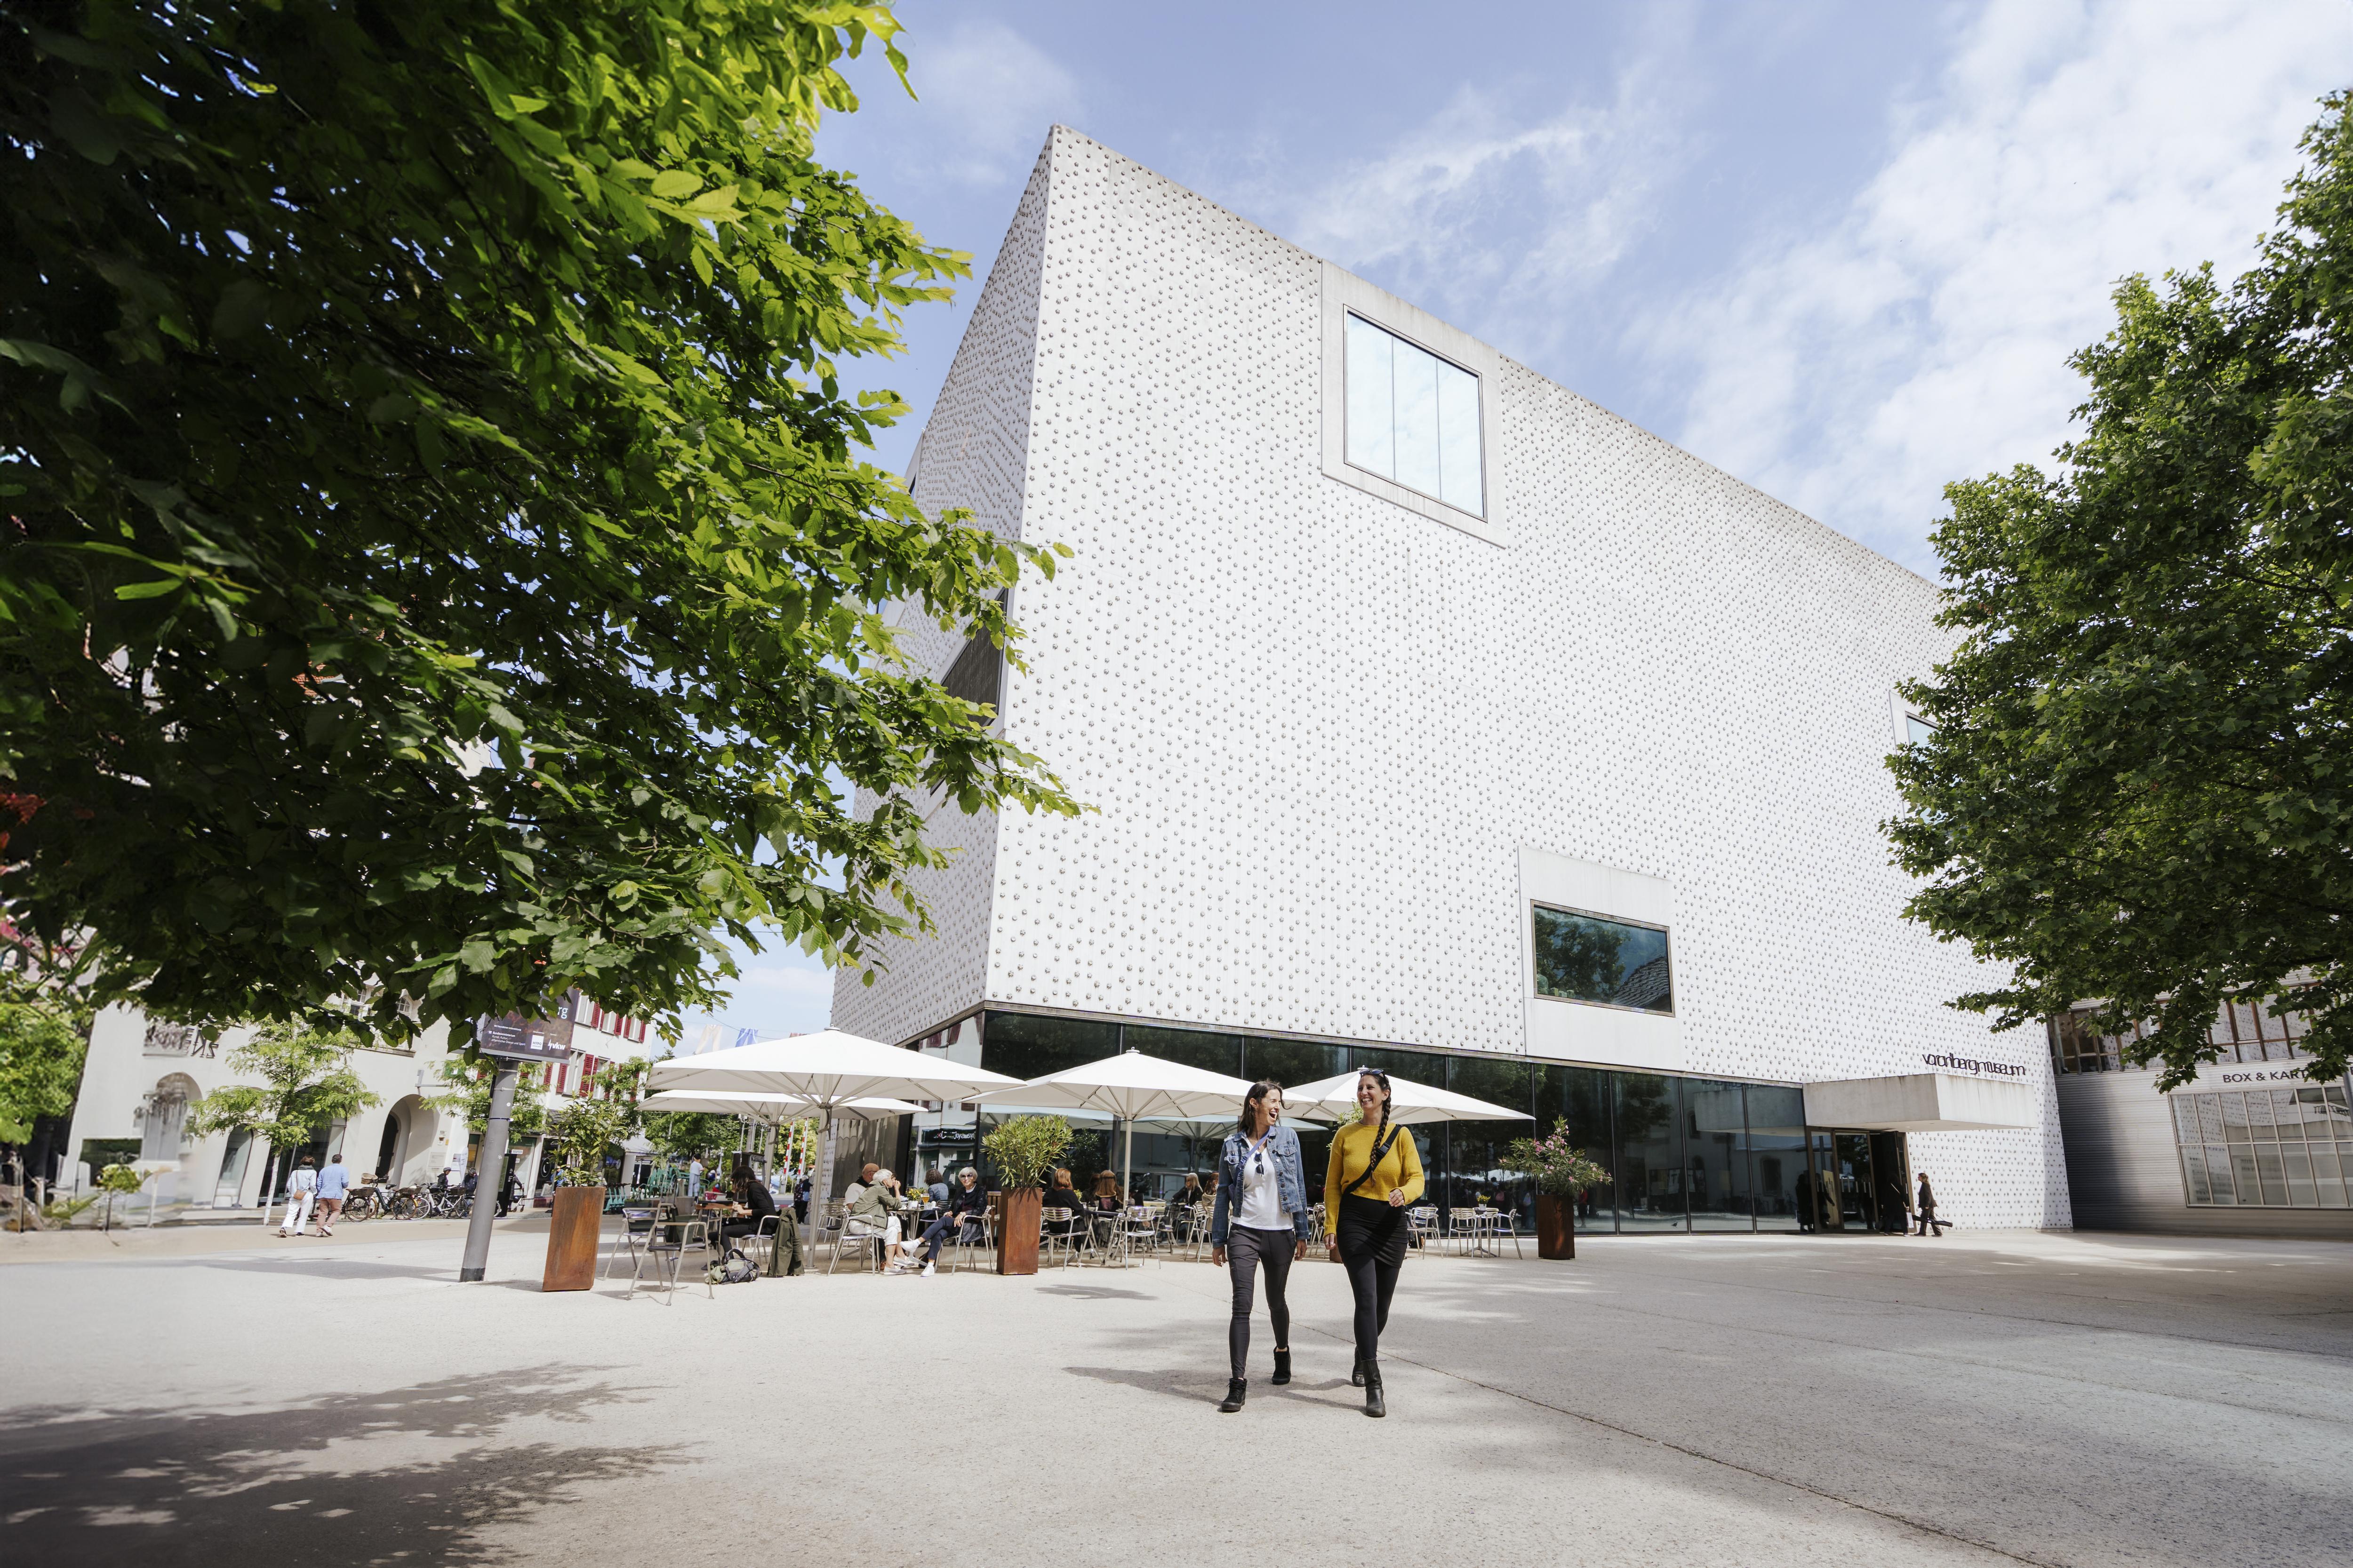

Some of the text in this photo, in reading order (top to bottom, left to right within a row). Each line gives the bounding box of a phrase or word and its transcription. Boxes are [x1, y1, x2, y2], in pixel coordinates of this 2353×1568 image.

[552, 1042, 566, 1050] vkw
[2222, 1069, 2307, 1083] BOX & KART
